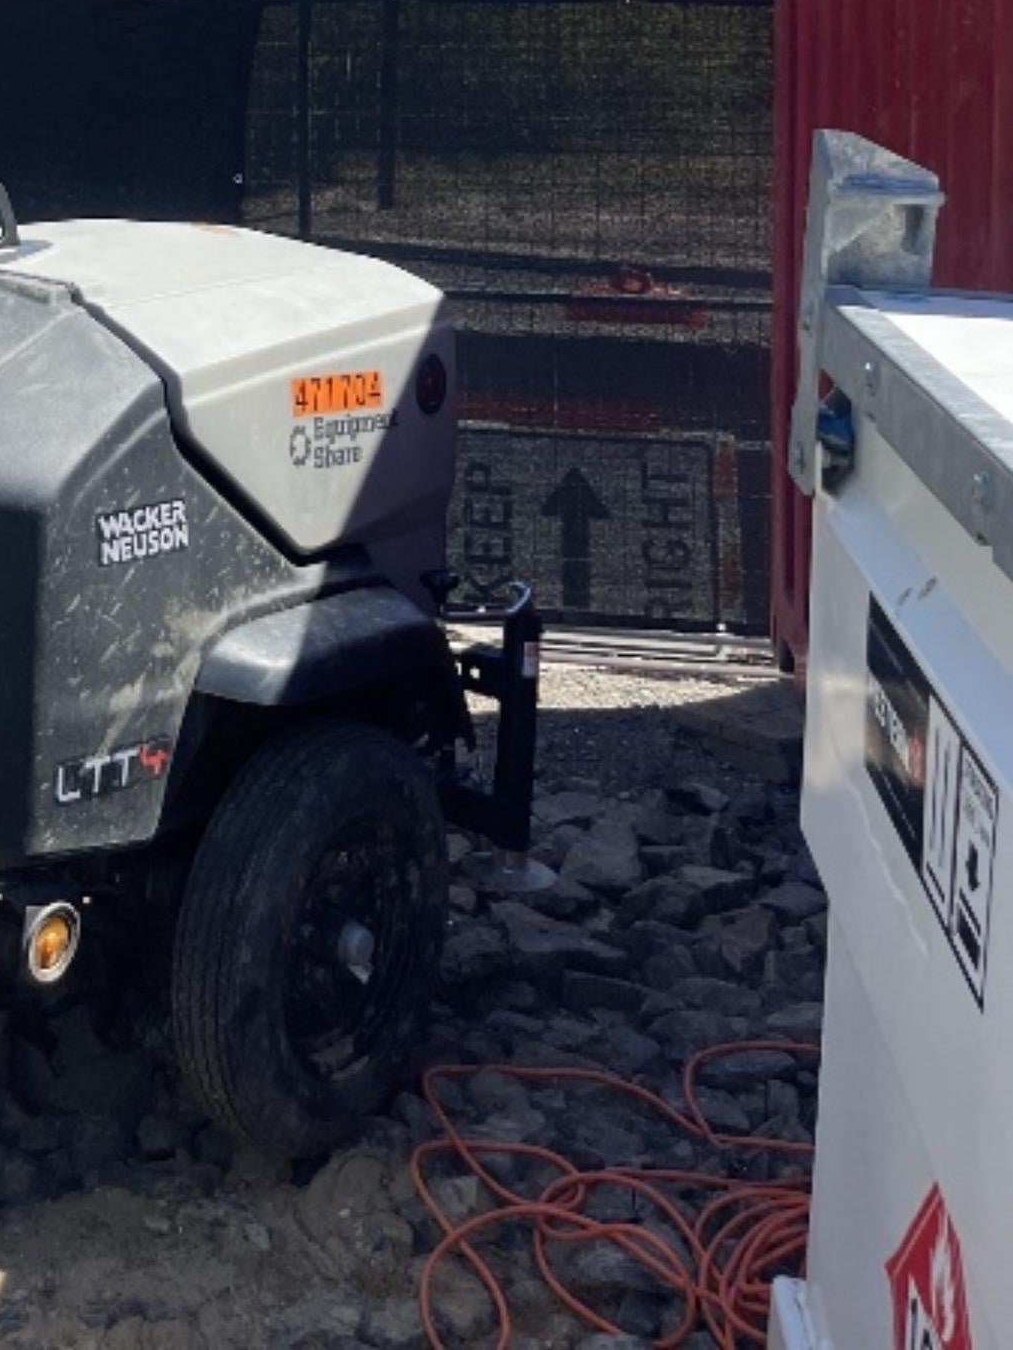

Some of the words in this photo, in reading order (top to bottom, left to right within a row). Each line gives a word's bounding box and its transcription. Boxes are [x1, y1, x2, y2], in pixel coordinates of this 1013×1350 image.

[294, 371, 380, 412] 471704
[313, 444, 363, 469] Share
[98, 500, 186, 540] WACKER
[100, 524, 189, 565] NEUSON
